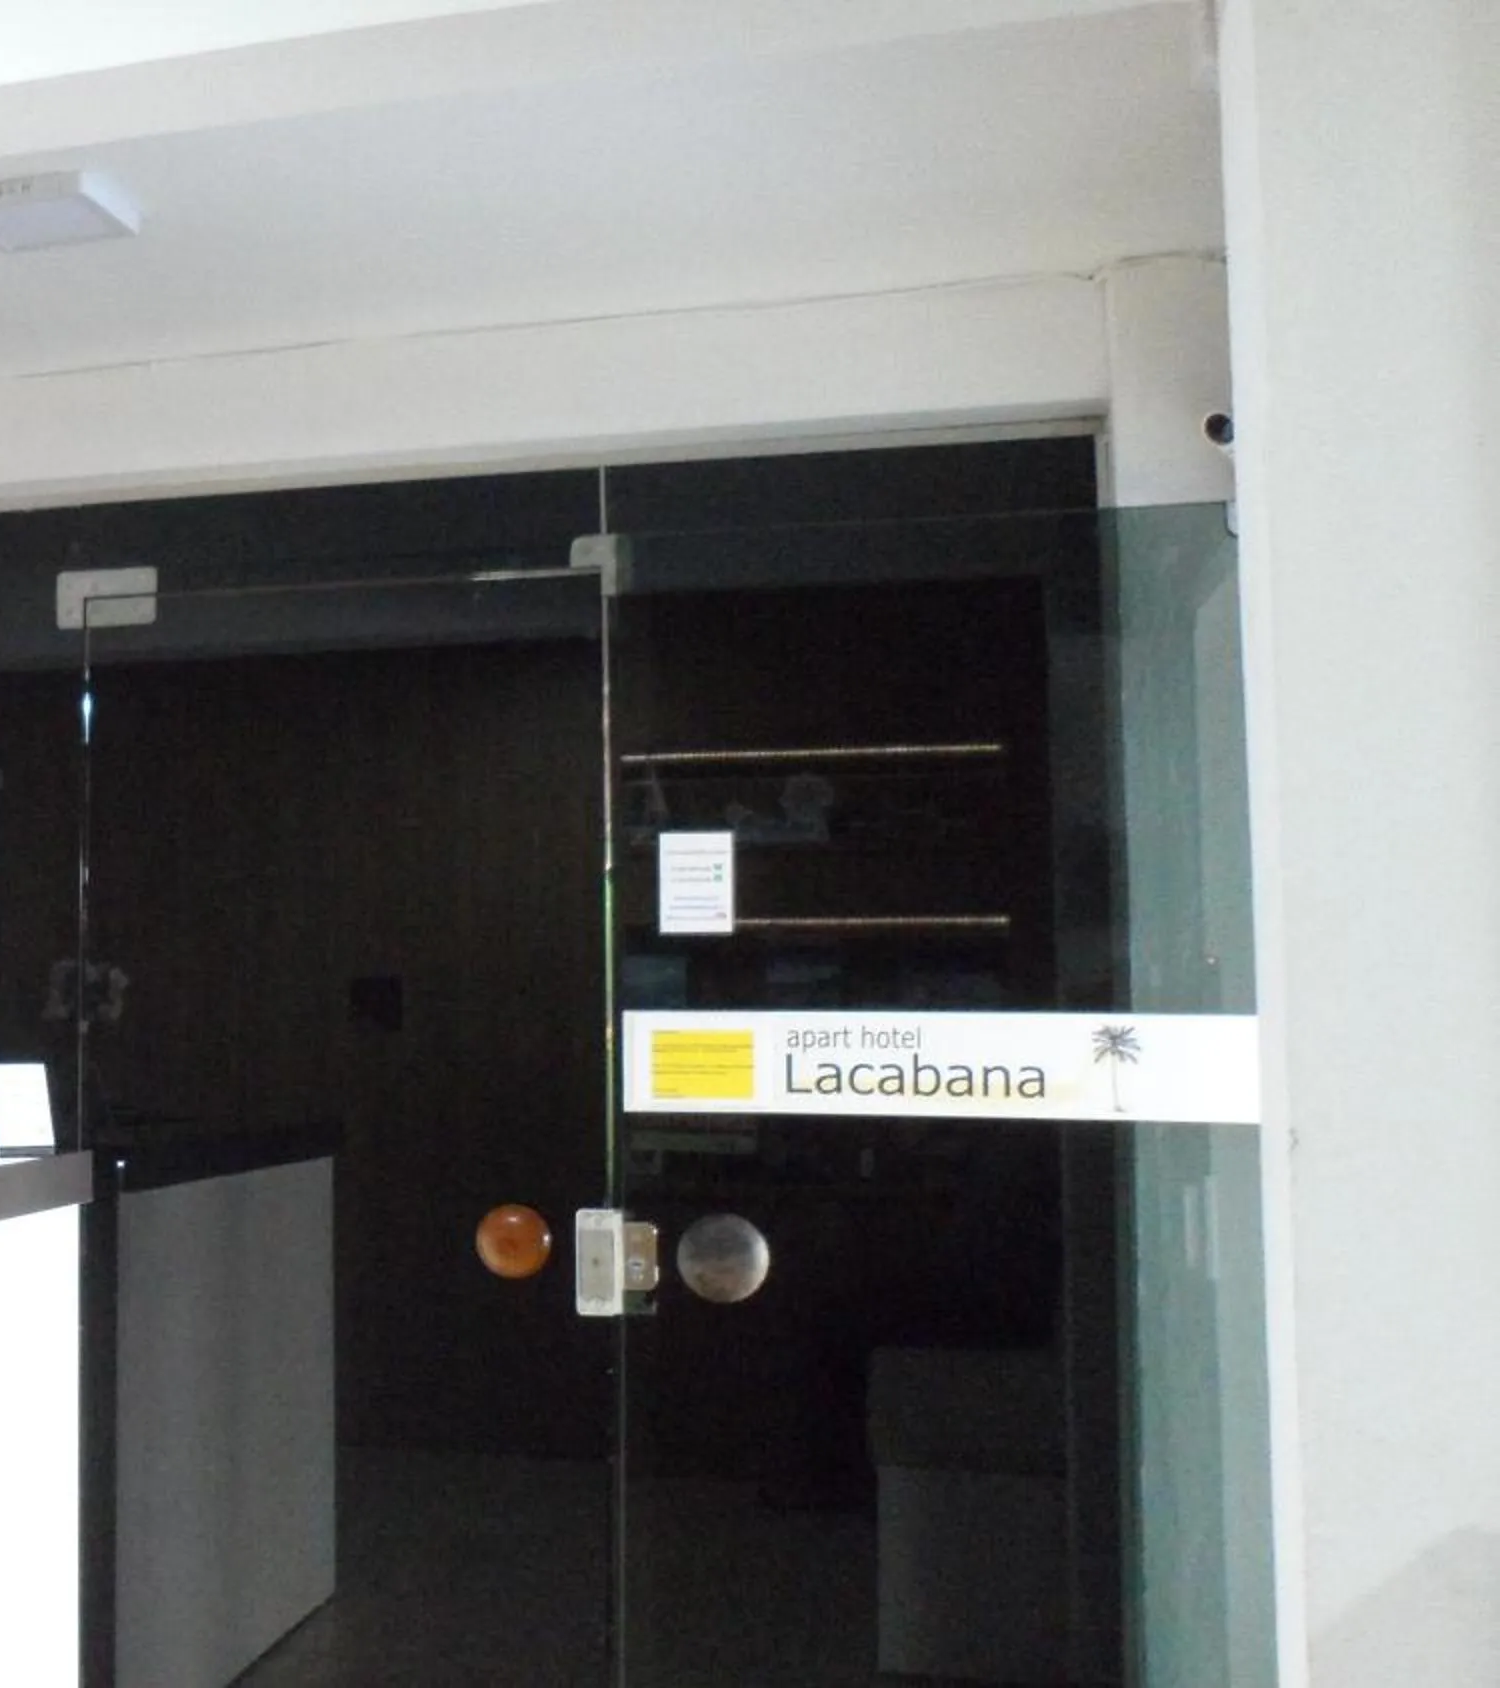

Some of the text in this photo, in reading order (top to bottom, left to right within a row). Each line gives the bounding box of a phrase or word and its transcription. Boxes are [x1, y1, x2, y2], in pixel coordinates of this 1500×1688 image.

[786, 1025, 922, 1052] apart hotel
[785, 1052, 1046, 1099] Lacabana
